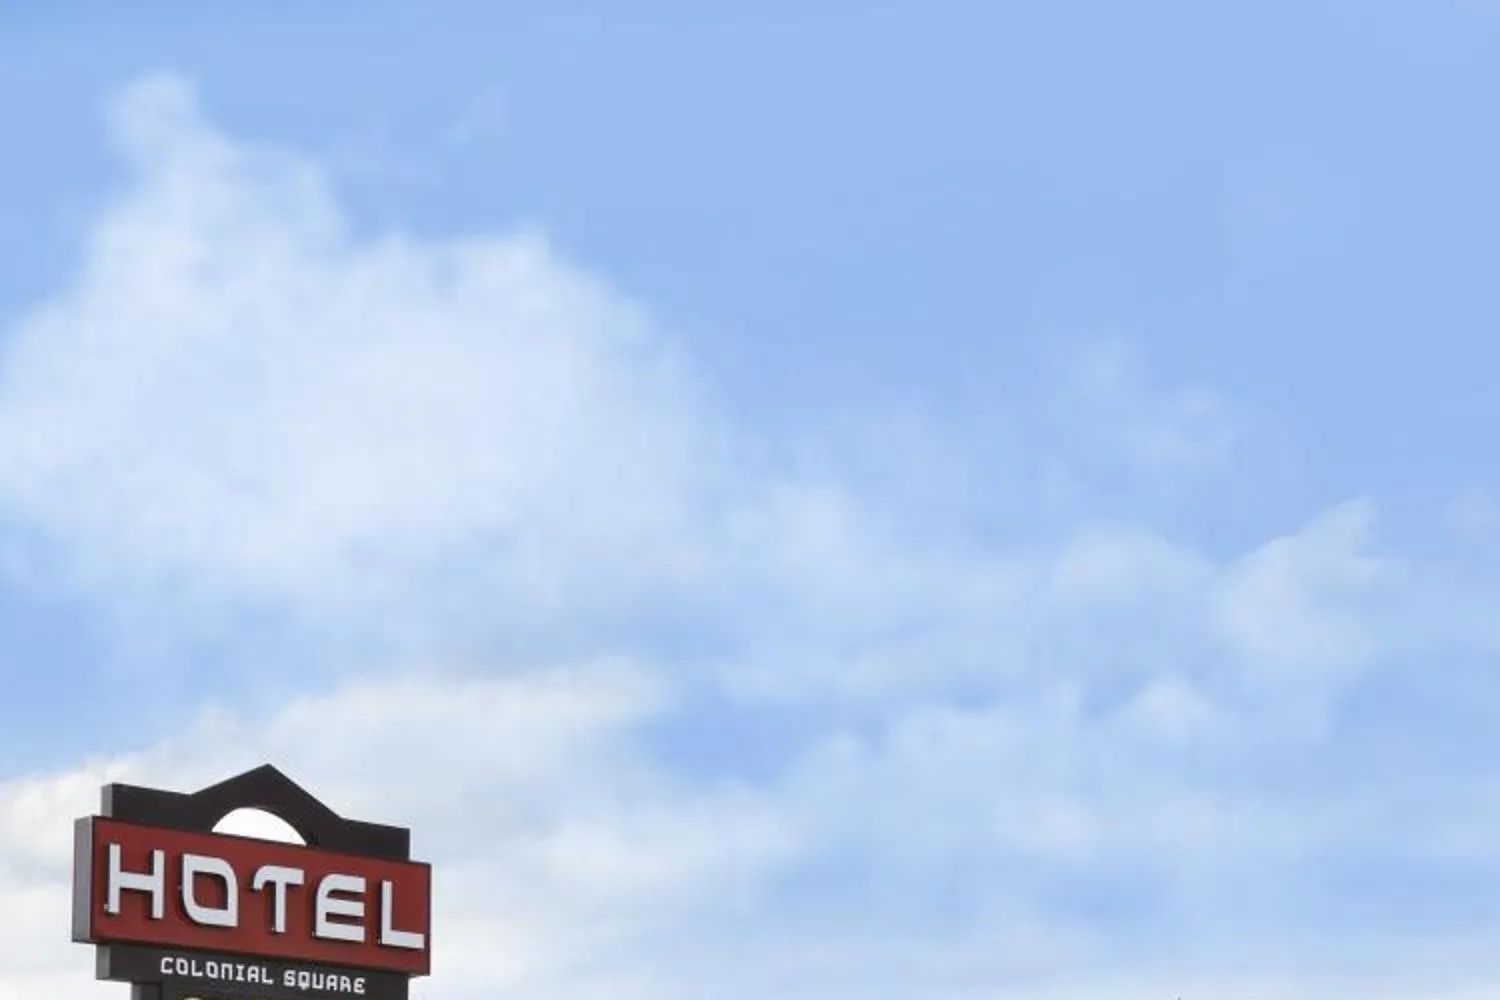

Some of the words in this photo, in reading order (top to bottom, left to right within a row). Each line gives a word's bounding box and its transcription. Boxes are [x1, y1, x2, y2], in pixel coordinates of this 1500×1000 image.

[106, 843, 425, 949] HOTEL
[160, 957, 274, 984] COLONIAL
[283, 969, 366, 994] SQUARE
